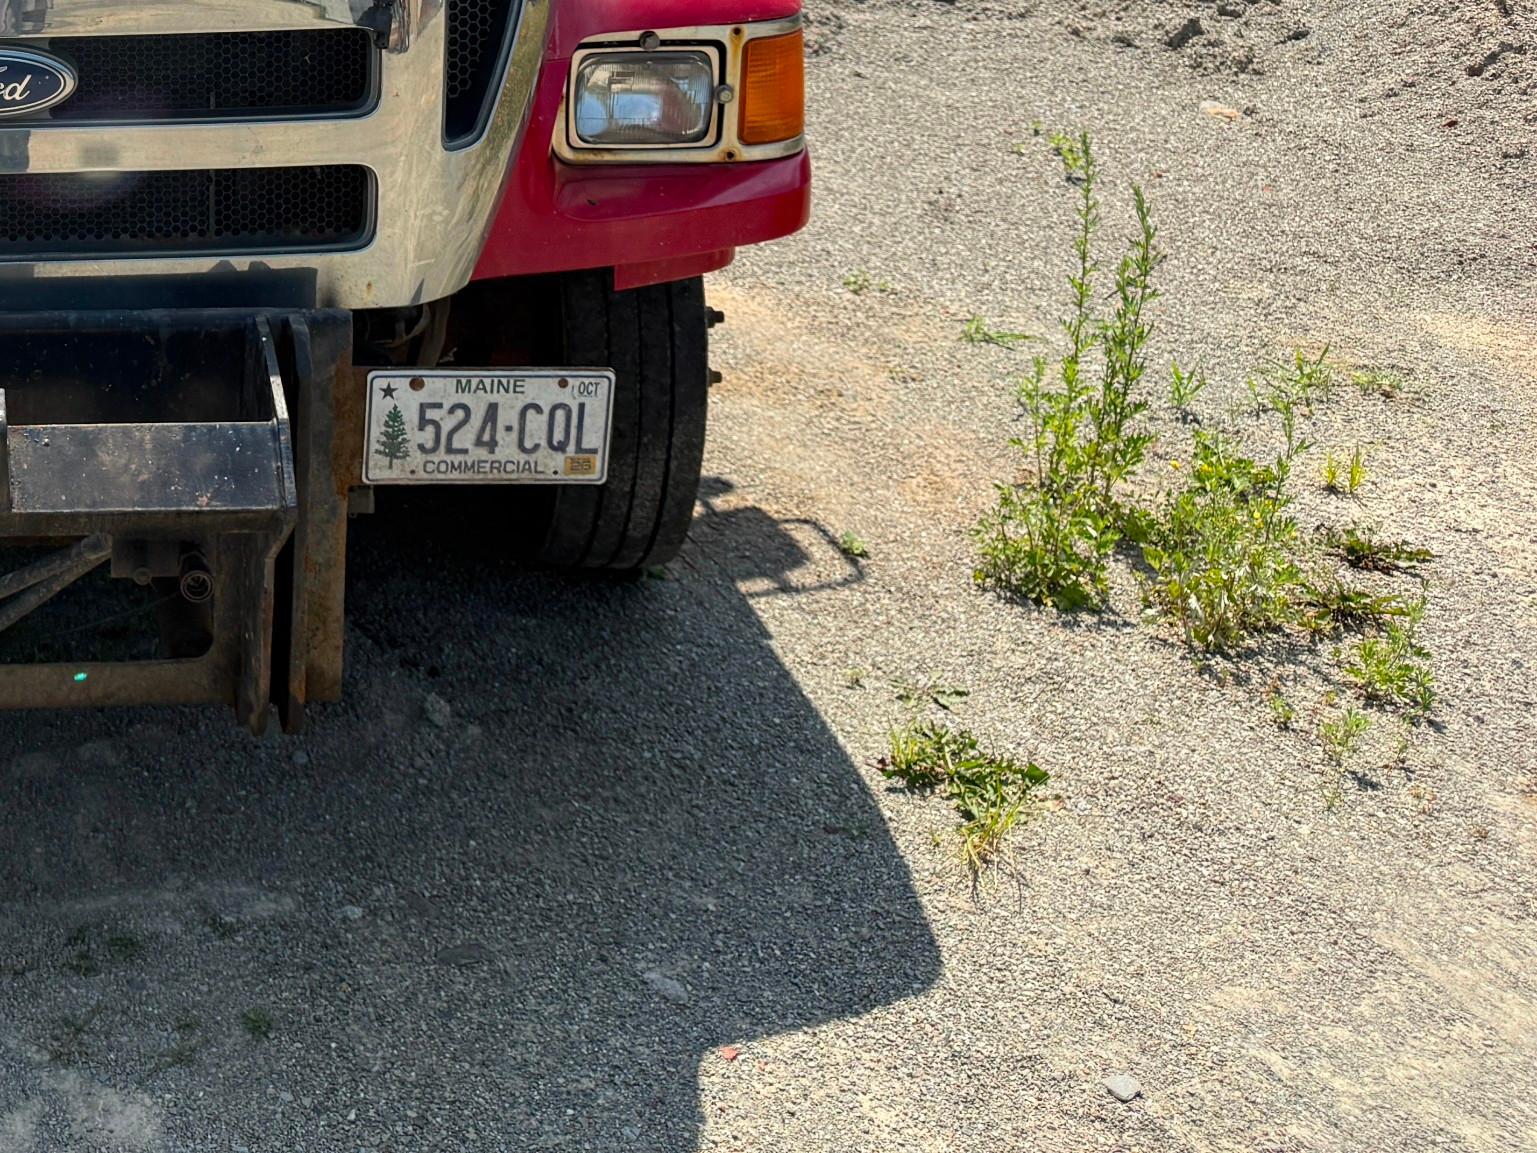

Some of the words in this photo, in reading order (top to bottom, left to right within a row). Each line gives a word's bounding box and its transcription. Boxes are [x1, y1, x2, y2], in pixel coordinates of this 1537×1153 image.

[455, 378, 526, 395] MAINE
[577, 381, 601, 397] OCT
[417, 401, 599, 455] 524-CQL
[422, 459, 546, 476] COMMERCIAL
